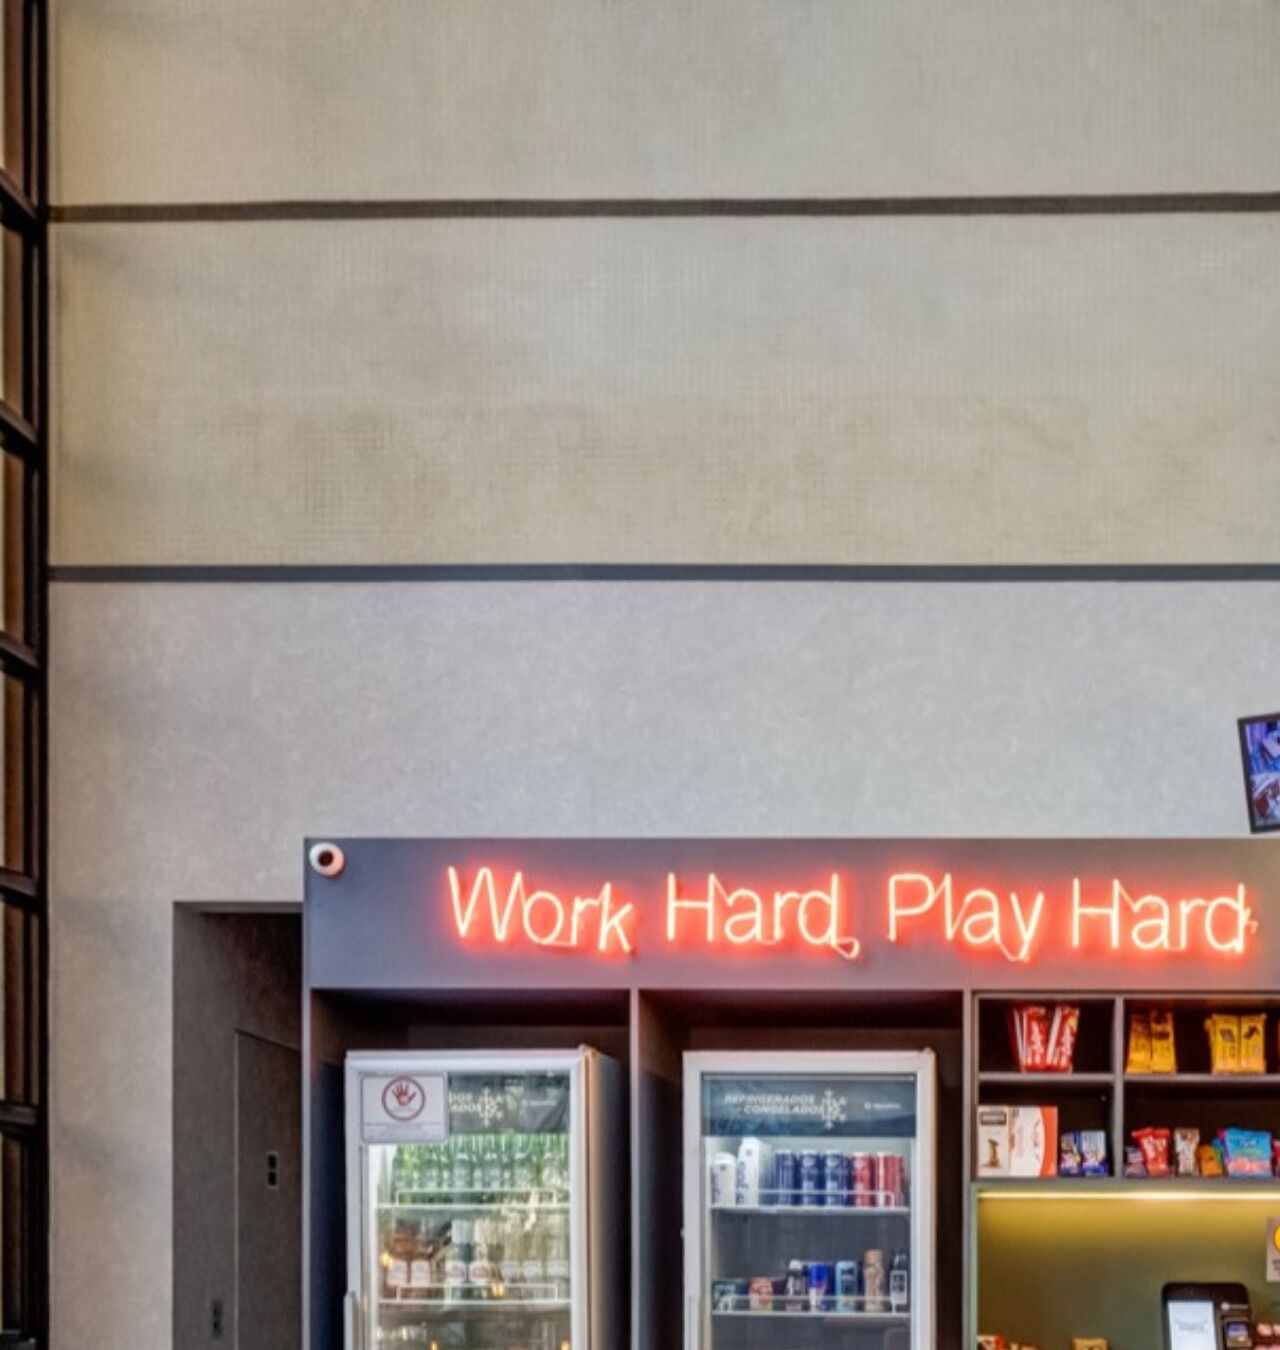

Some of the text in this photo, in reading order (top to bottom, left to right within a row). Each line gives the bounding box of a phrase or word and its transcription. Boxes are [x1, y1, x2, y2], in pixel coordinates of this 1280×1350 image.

[447, 865, 635, 953] Work
[888, 873, 1045, 963] Play
[1072, 877, 1248, 954] Hard
